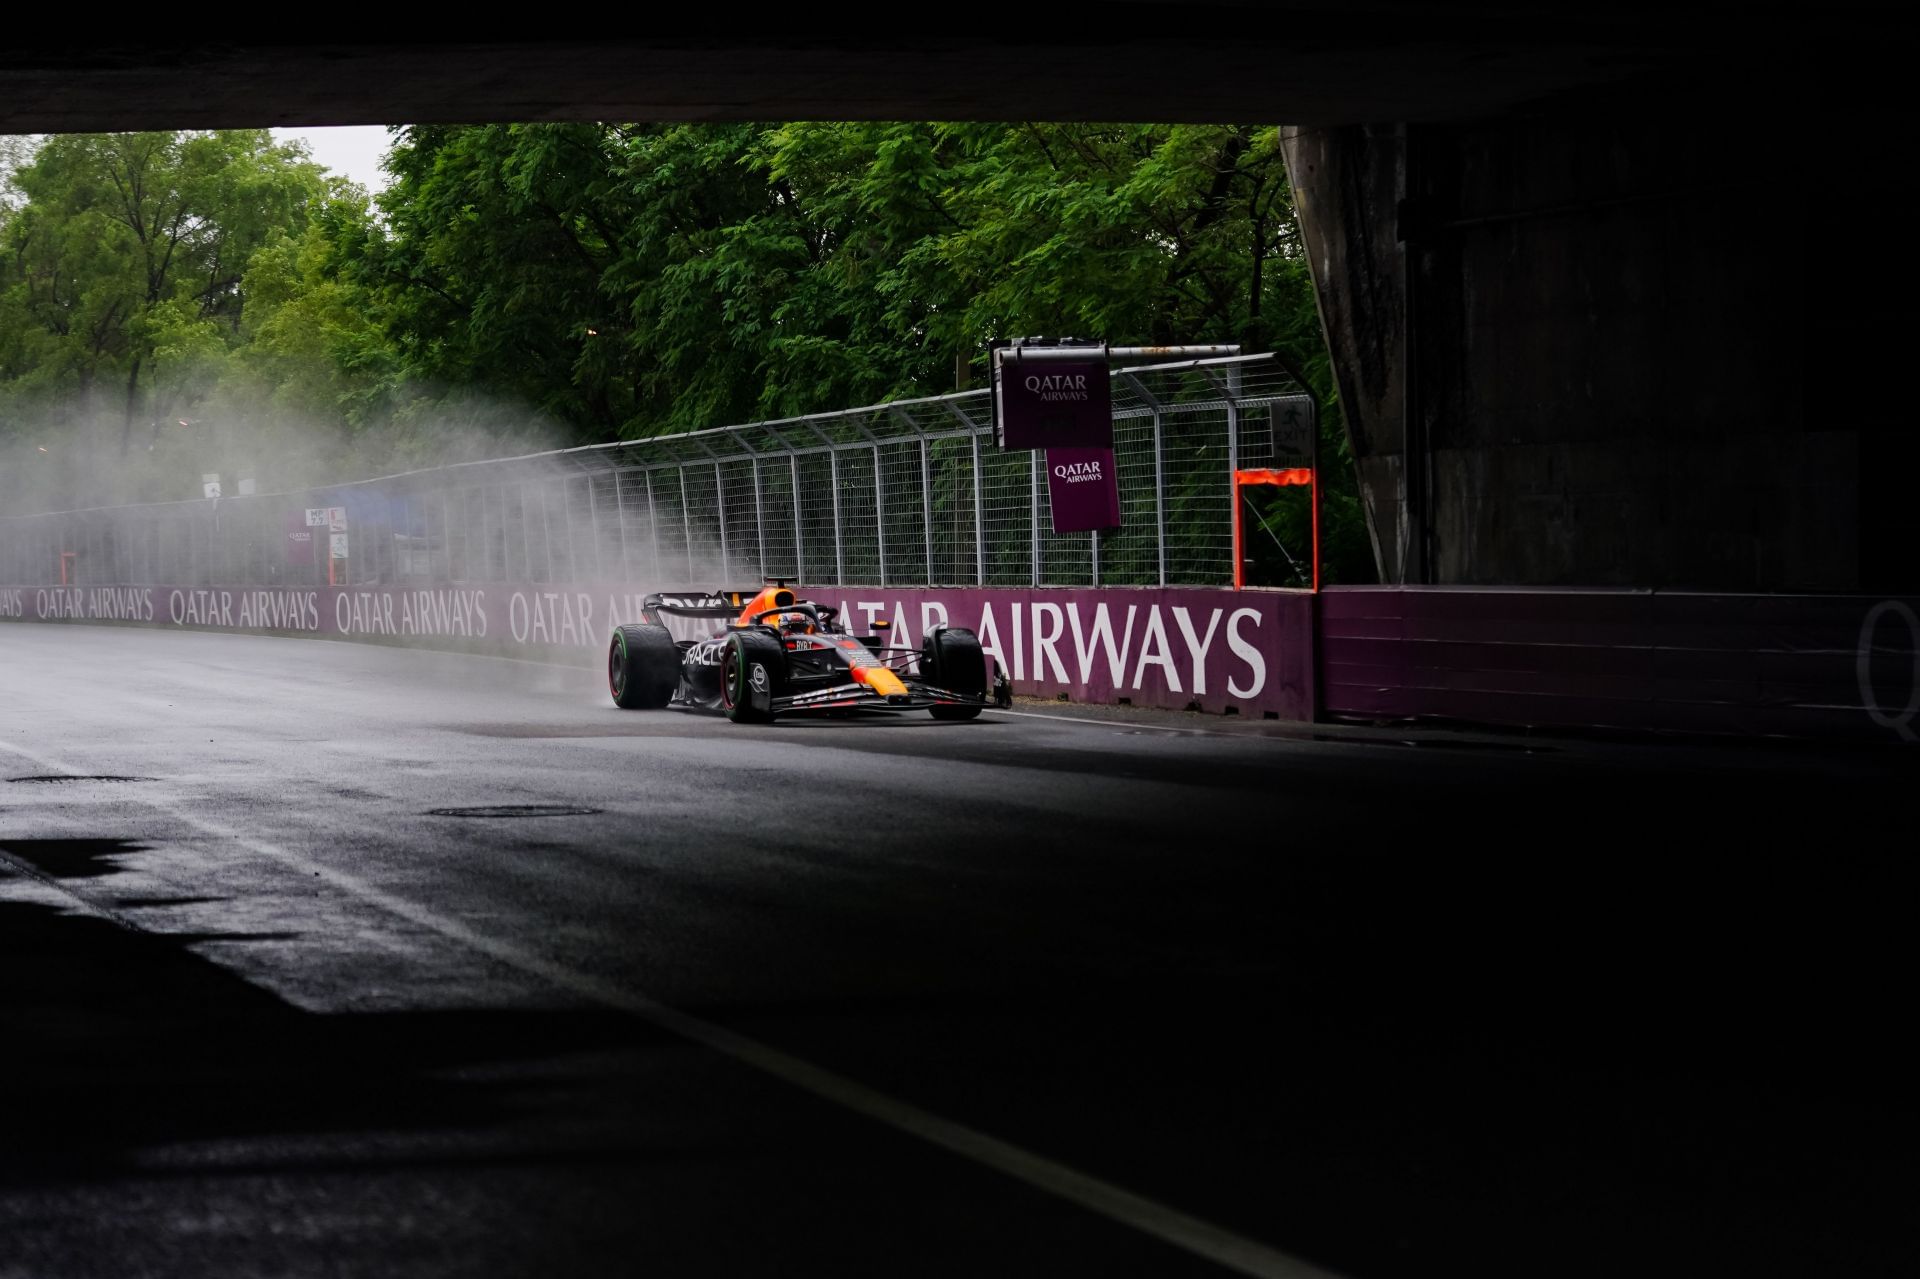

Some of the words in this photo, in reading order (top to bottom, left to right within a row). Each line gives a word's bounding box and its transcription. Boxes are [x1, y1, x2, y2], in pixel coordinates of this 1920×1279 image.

[1025, 375, 1087, 391] QATAR
[1040, 390, 1088, 401] AIRWAYS
[1054, 461, 1101, 478] QATAR
[1066, 472, 1102, 484] AIRWAYS
[0, 589, 22, 618] AYS
[36, 588, 84, 620] QATAR
[88, 587, 153, 621] AIRWAYS
[170, 589, 233, 626] QATAR
[239, 591, 319, 631] AIRWAYS
[335, 591, 397, 635] QATAR
[401, 589, 487, 638] AIRWAYS
[509, 591, 598, 647] QATAR
[978, 600, 1267, 699] AIRWAYS
